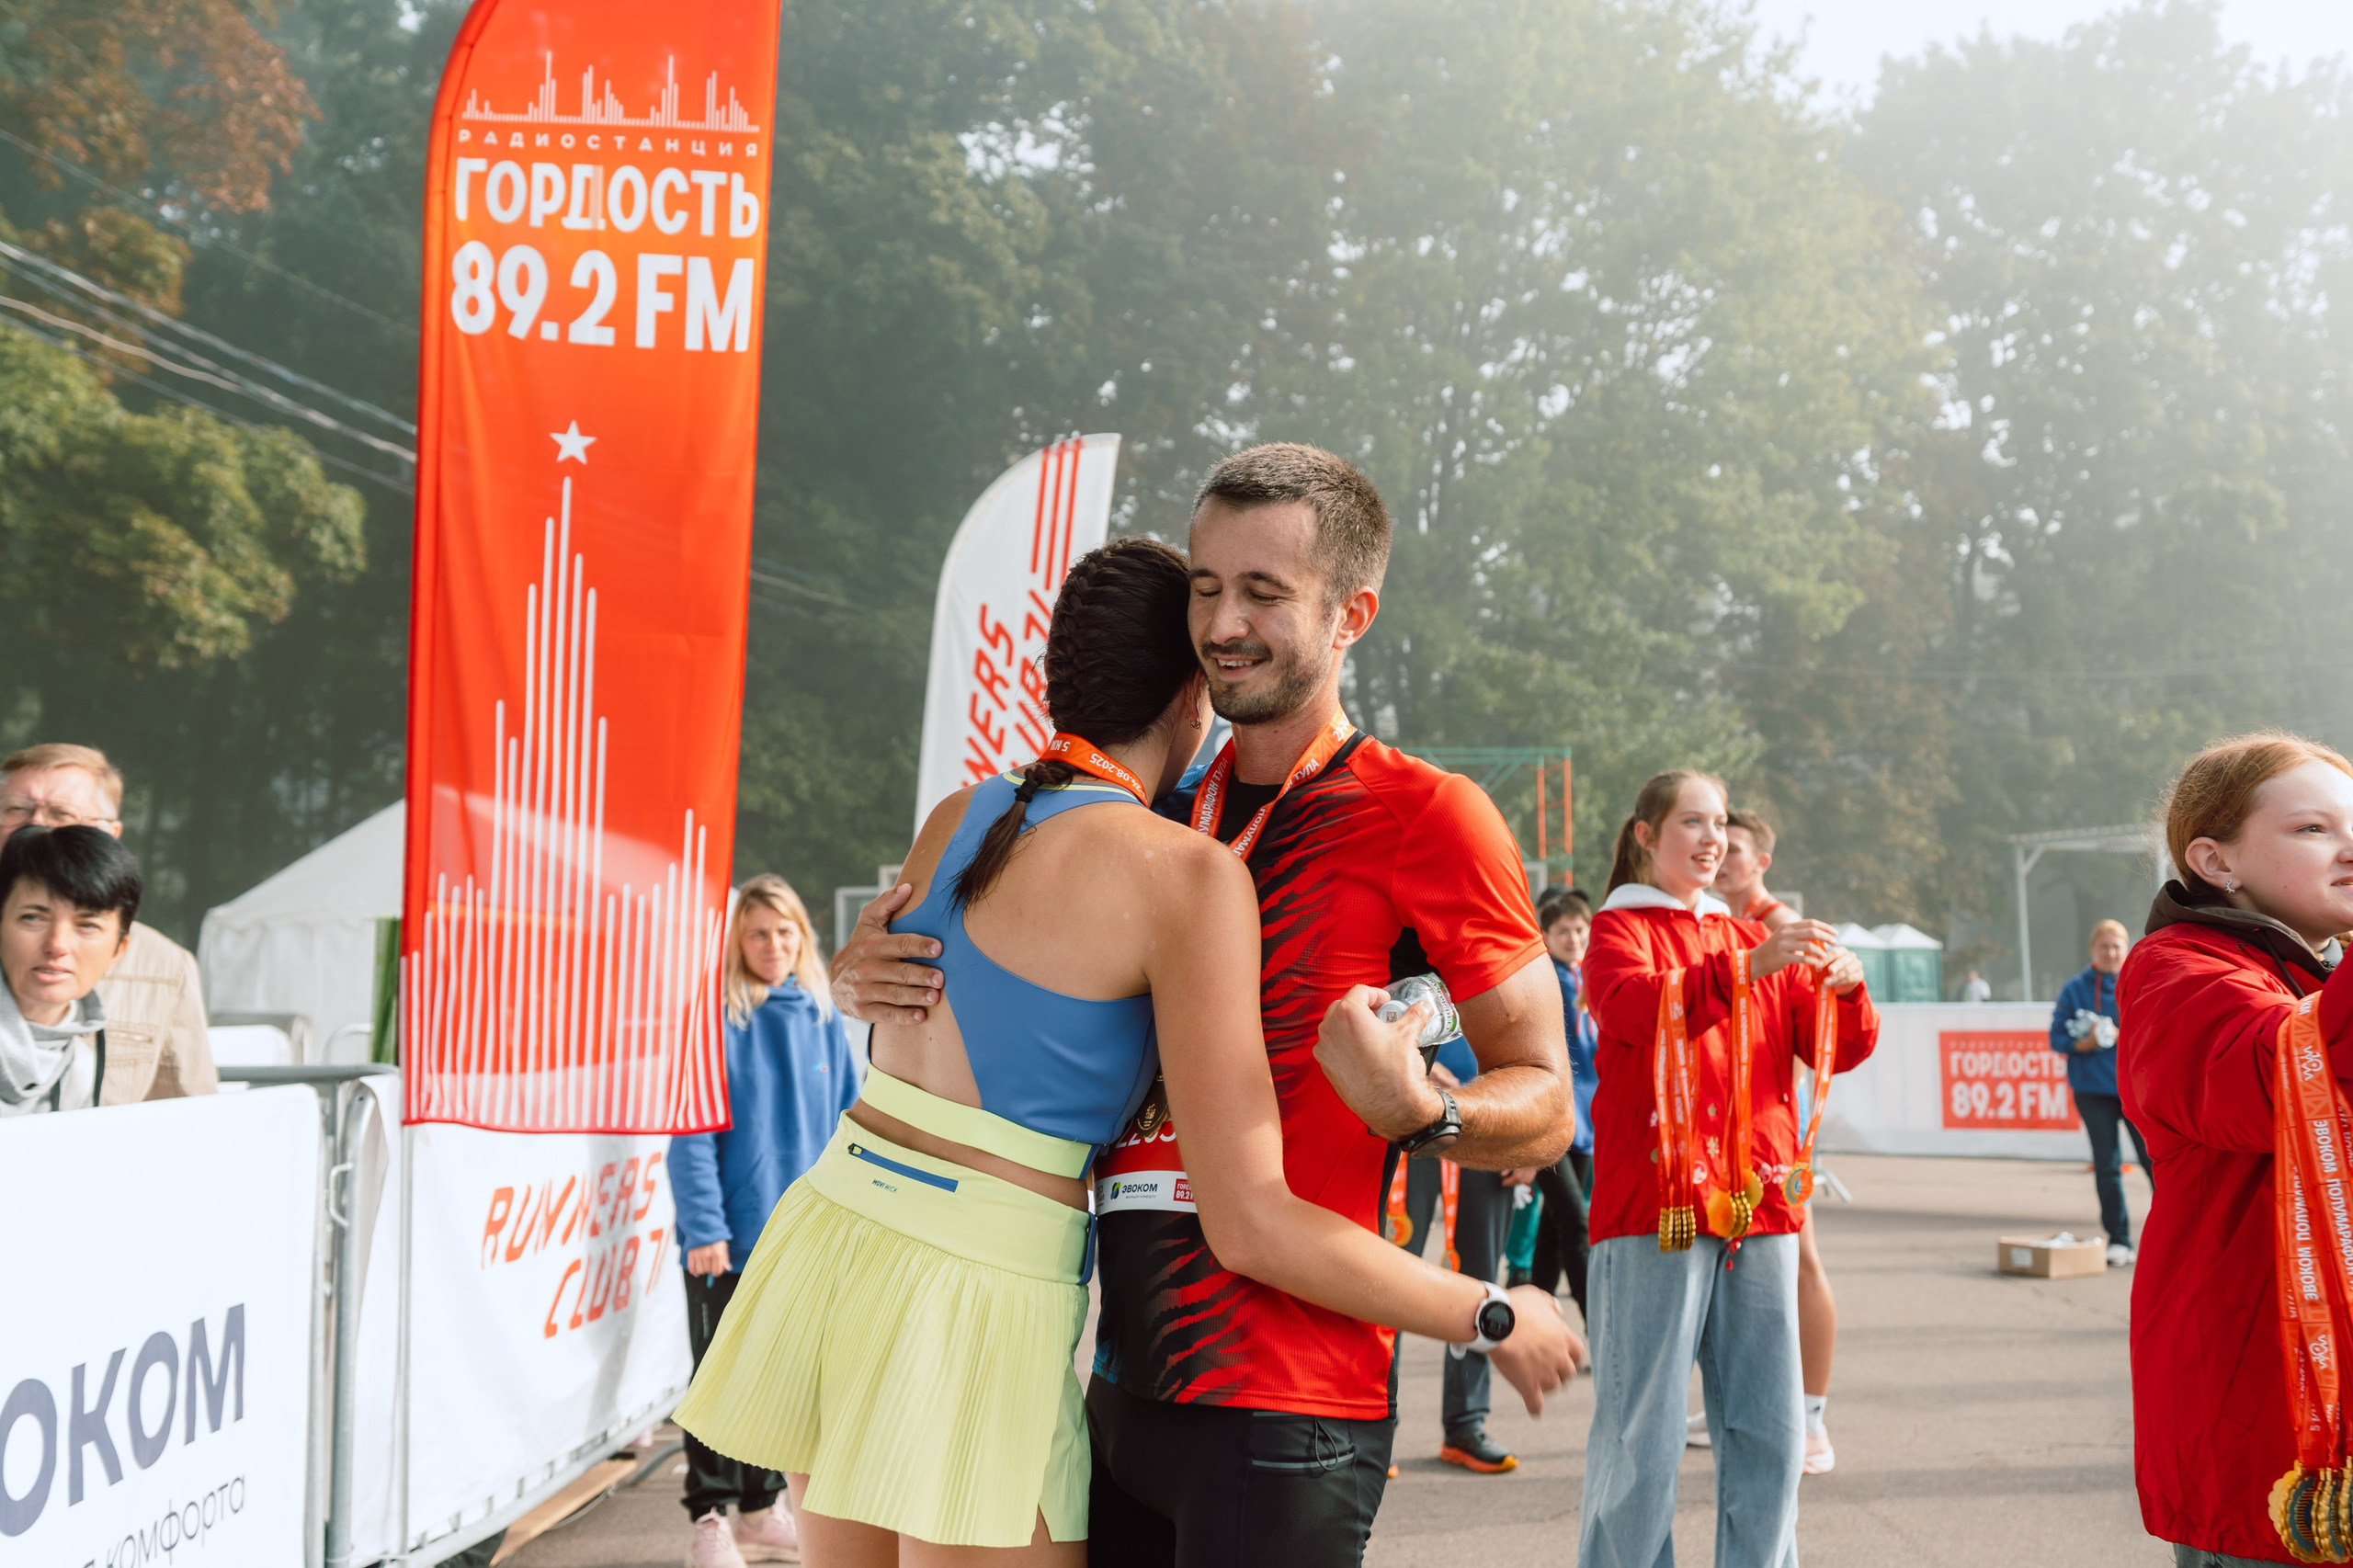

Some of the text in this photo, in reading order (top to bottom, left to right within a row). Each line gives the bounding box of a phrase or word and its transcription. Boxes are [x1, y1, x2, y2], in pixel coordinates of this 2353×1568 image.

[459, 129, 758, 157] РАДИОСТАНЦИЯ
[455, 156, 760, 238] ГОРДОСТЬ
[450, 240, 755, 353] 89.2 FM
[961, 603, 1014, 788] NERS
[1061, 741, 1071, 752] 5
[1212, 757, 1228, 781] ТУЛА
[1293, 758, 1320, 780] ТУЛА
[1949, 1051, 2067, 1078] ГОРДОСТЬ
[1950, 1081, 2067, 1119] 89.2 FM
[2313, 1120, 2337, 1173] ЭВОКОМ
[481, 1152, 662, 1270] RUNNERS
[1121, 1183, 1158, 1193] ЭВОКОМ
[1176, 1190, 1189, 1199] 89.2
[543, 1236, 640, 1340] CLUB
[2297, 1247, 2319, 1301] ЭВОКОМ
[0, 1302, 244, 1537] ОКОМ
[107, 1474, 245, 1568] комфорта
